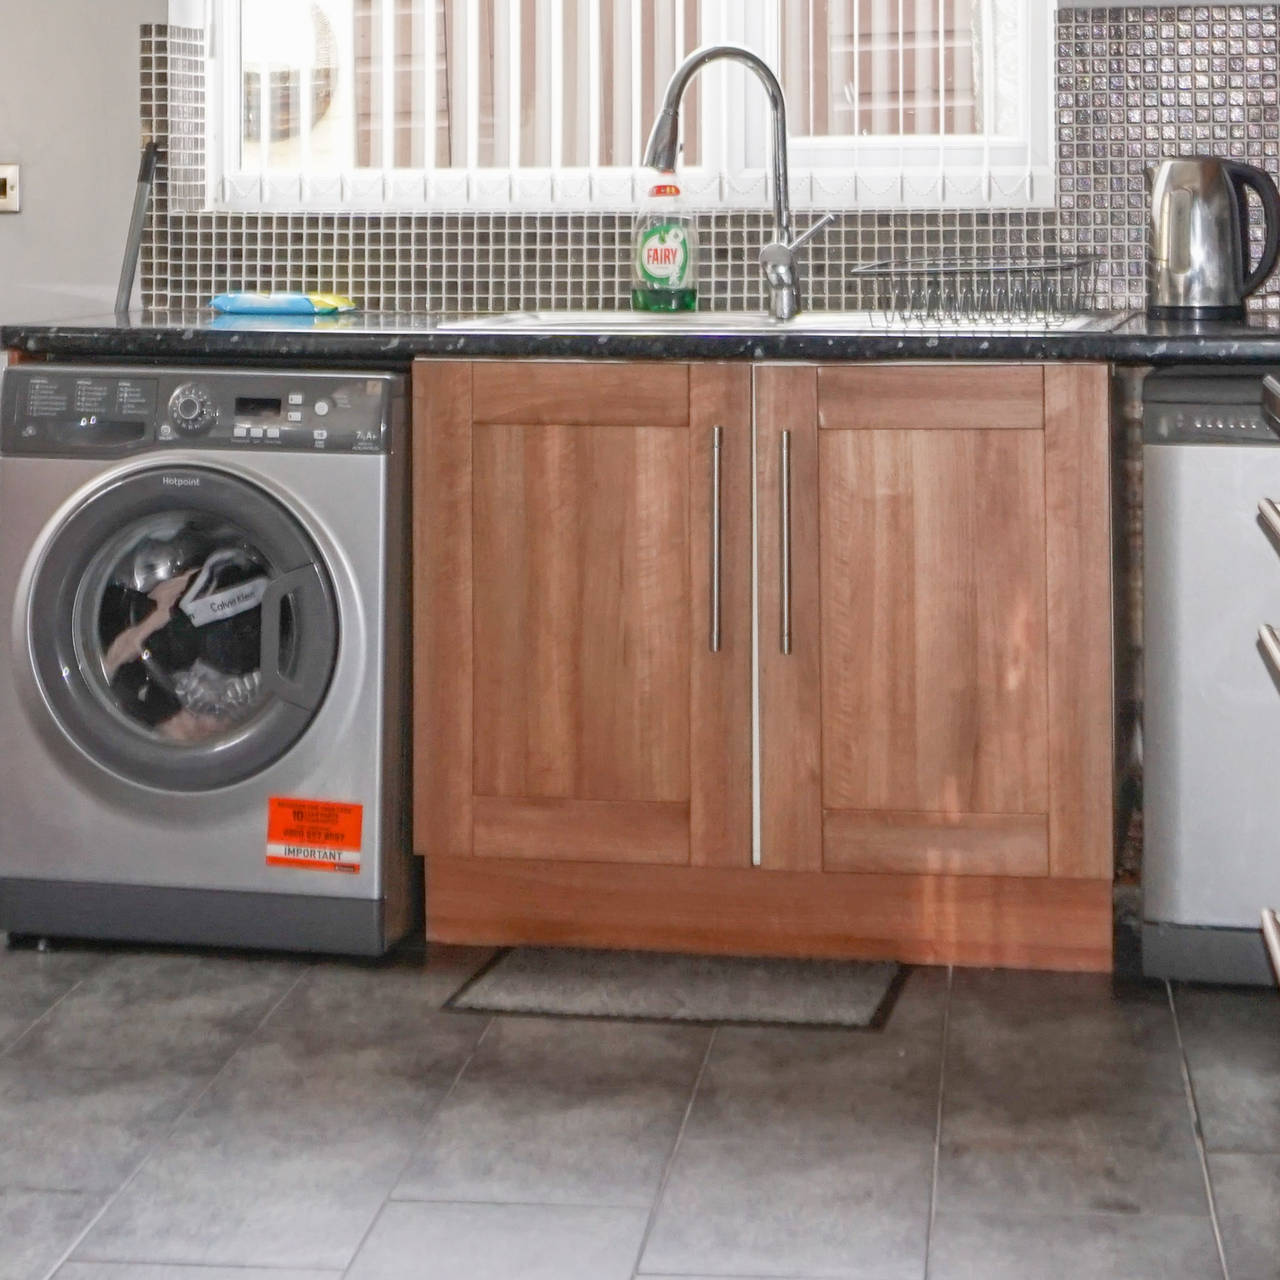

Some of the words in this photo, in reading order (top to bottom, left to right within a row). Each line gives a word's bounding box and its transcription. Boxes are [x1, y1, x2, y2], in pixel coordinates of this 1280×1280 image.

[646, 248, 678, 265] FAIRY
[162, 475, 200, 488] Hotpoint
[283, 846, 343, 861] IMPORTANT
